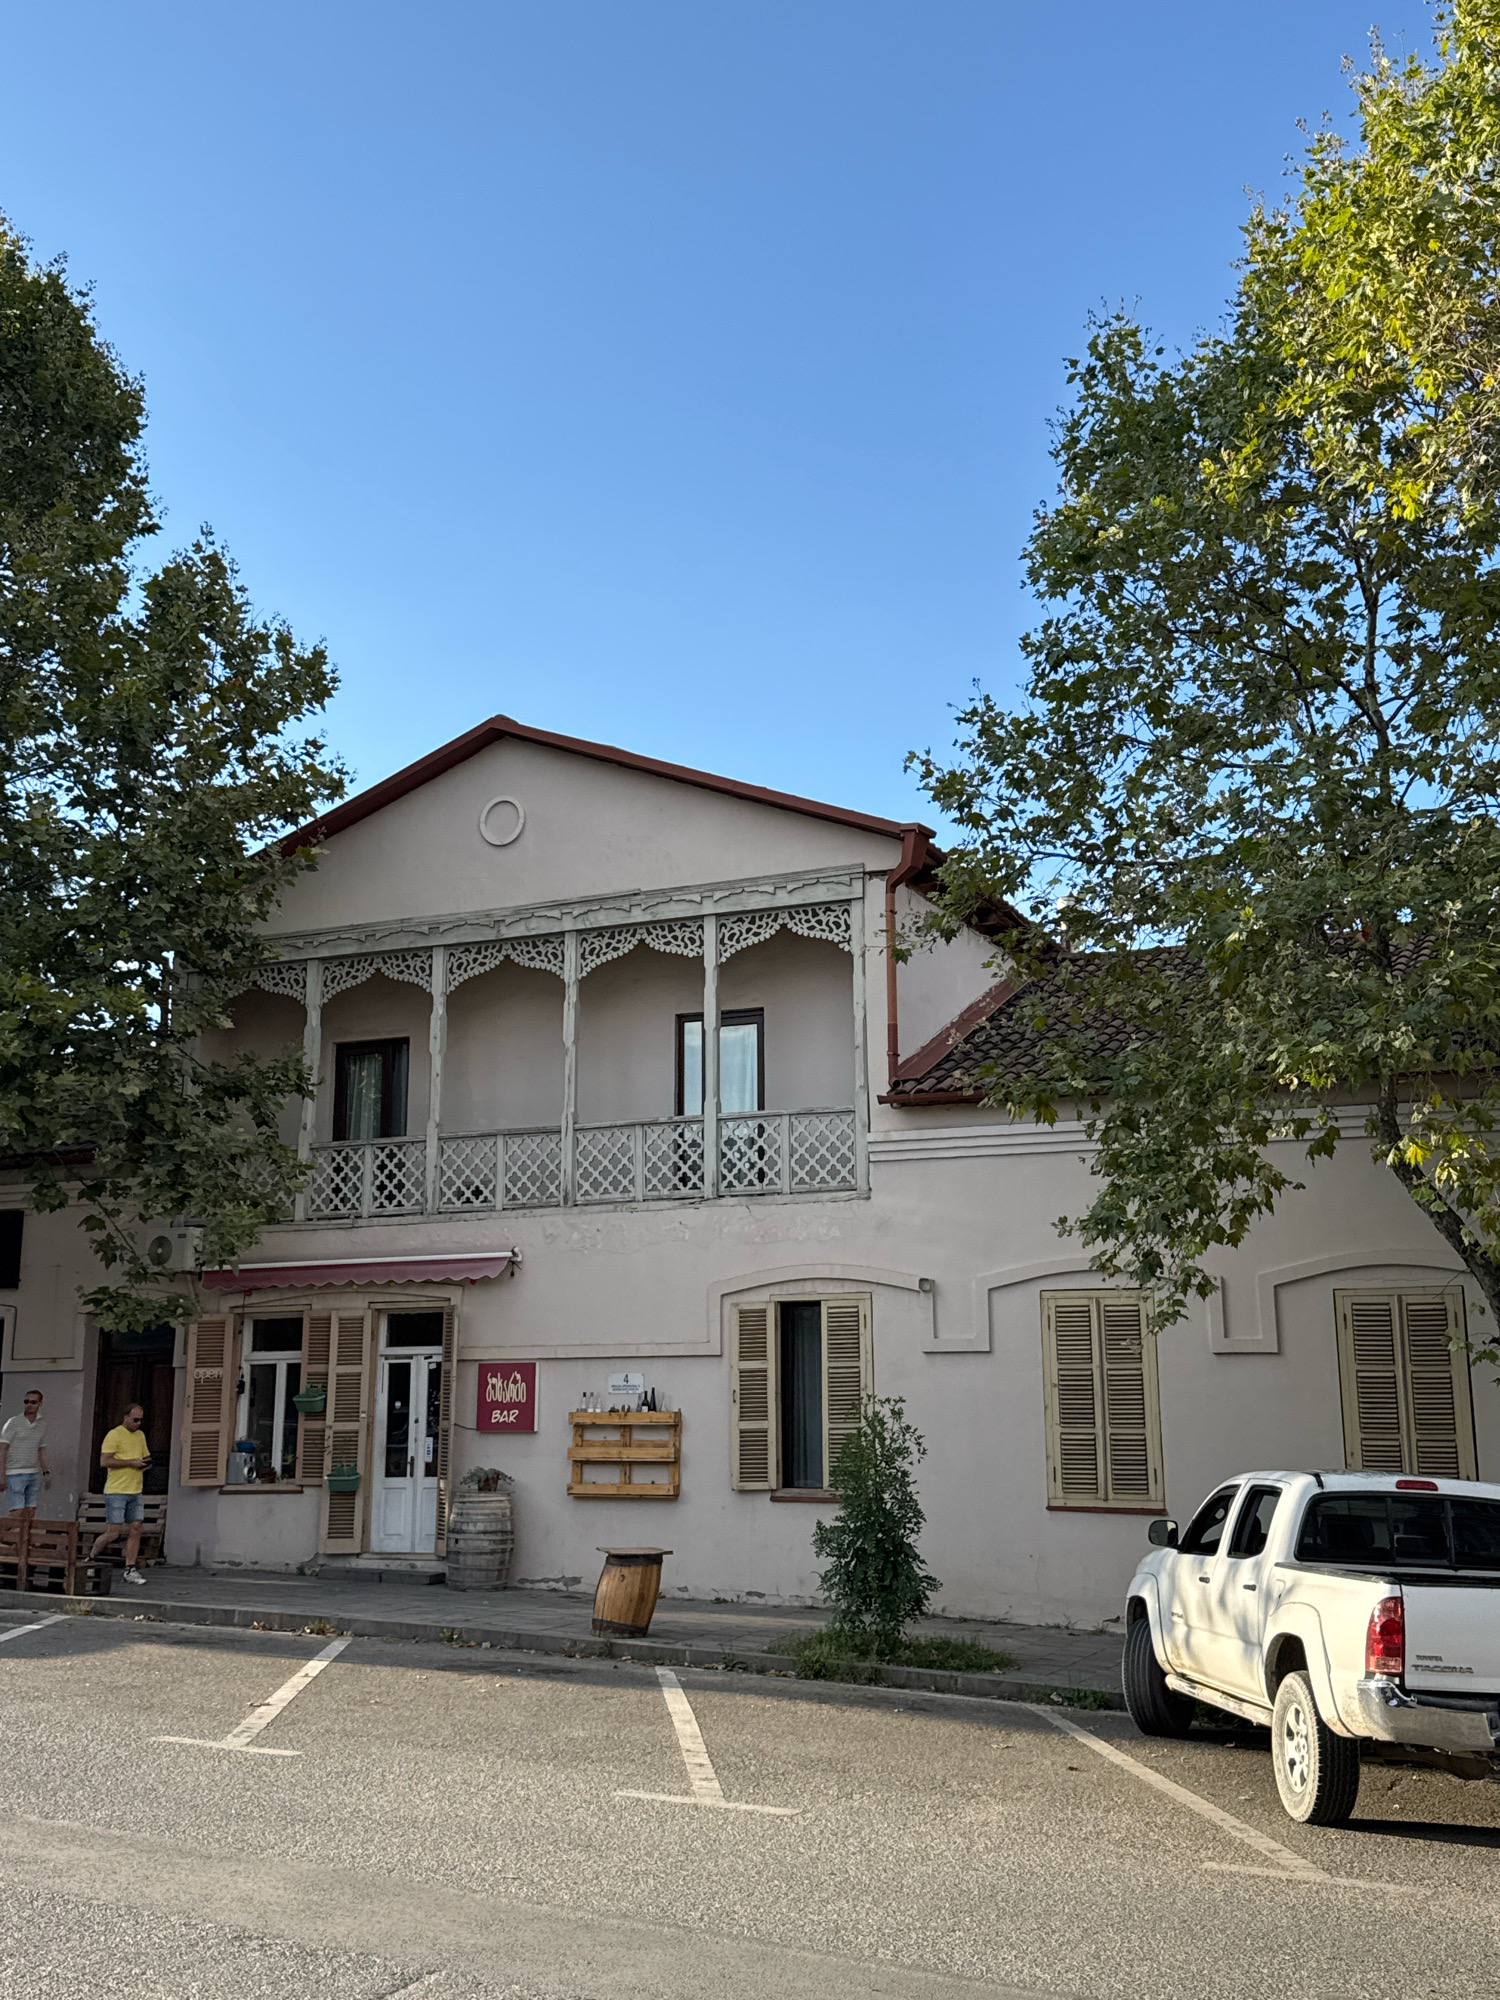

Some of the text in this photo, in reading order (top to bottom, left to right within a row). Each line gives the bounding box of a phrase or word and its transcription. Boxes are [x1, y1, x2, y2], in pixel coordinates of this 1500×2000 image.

[194, 1369, 223, 1384] open
[623, 1373, 629, 1384] 4
[491, 1409, 519, 1423] BAR
